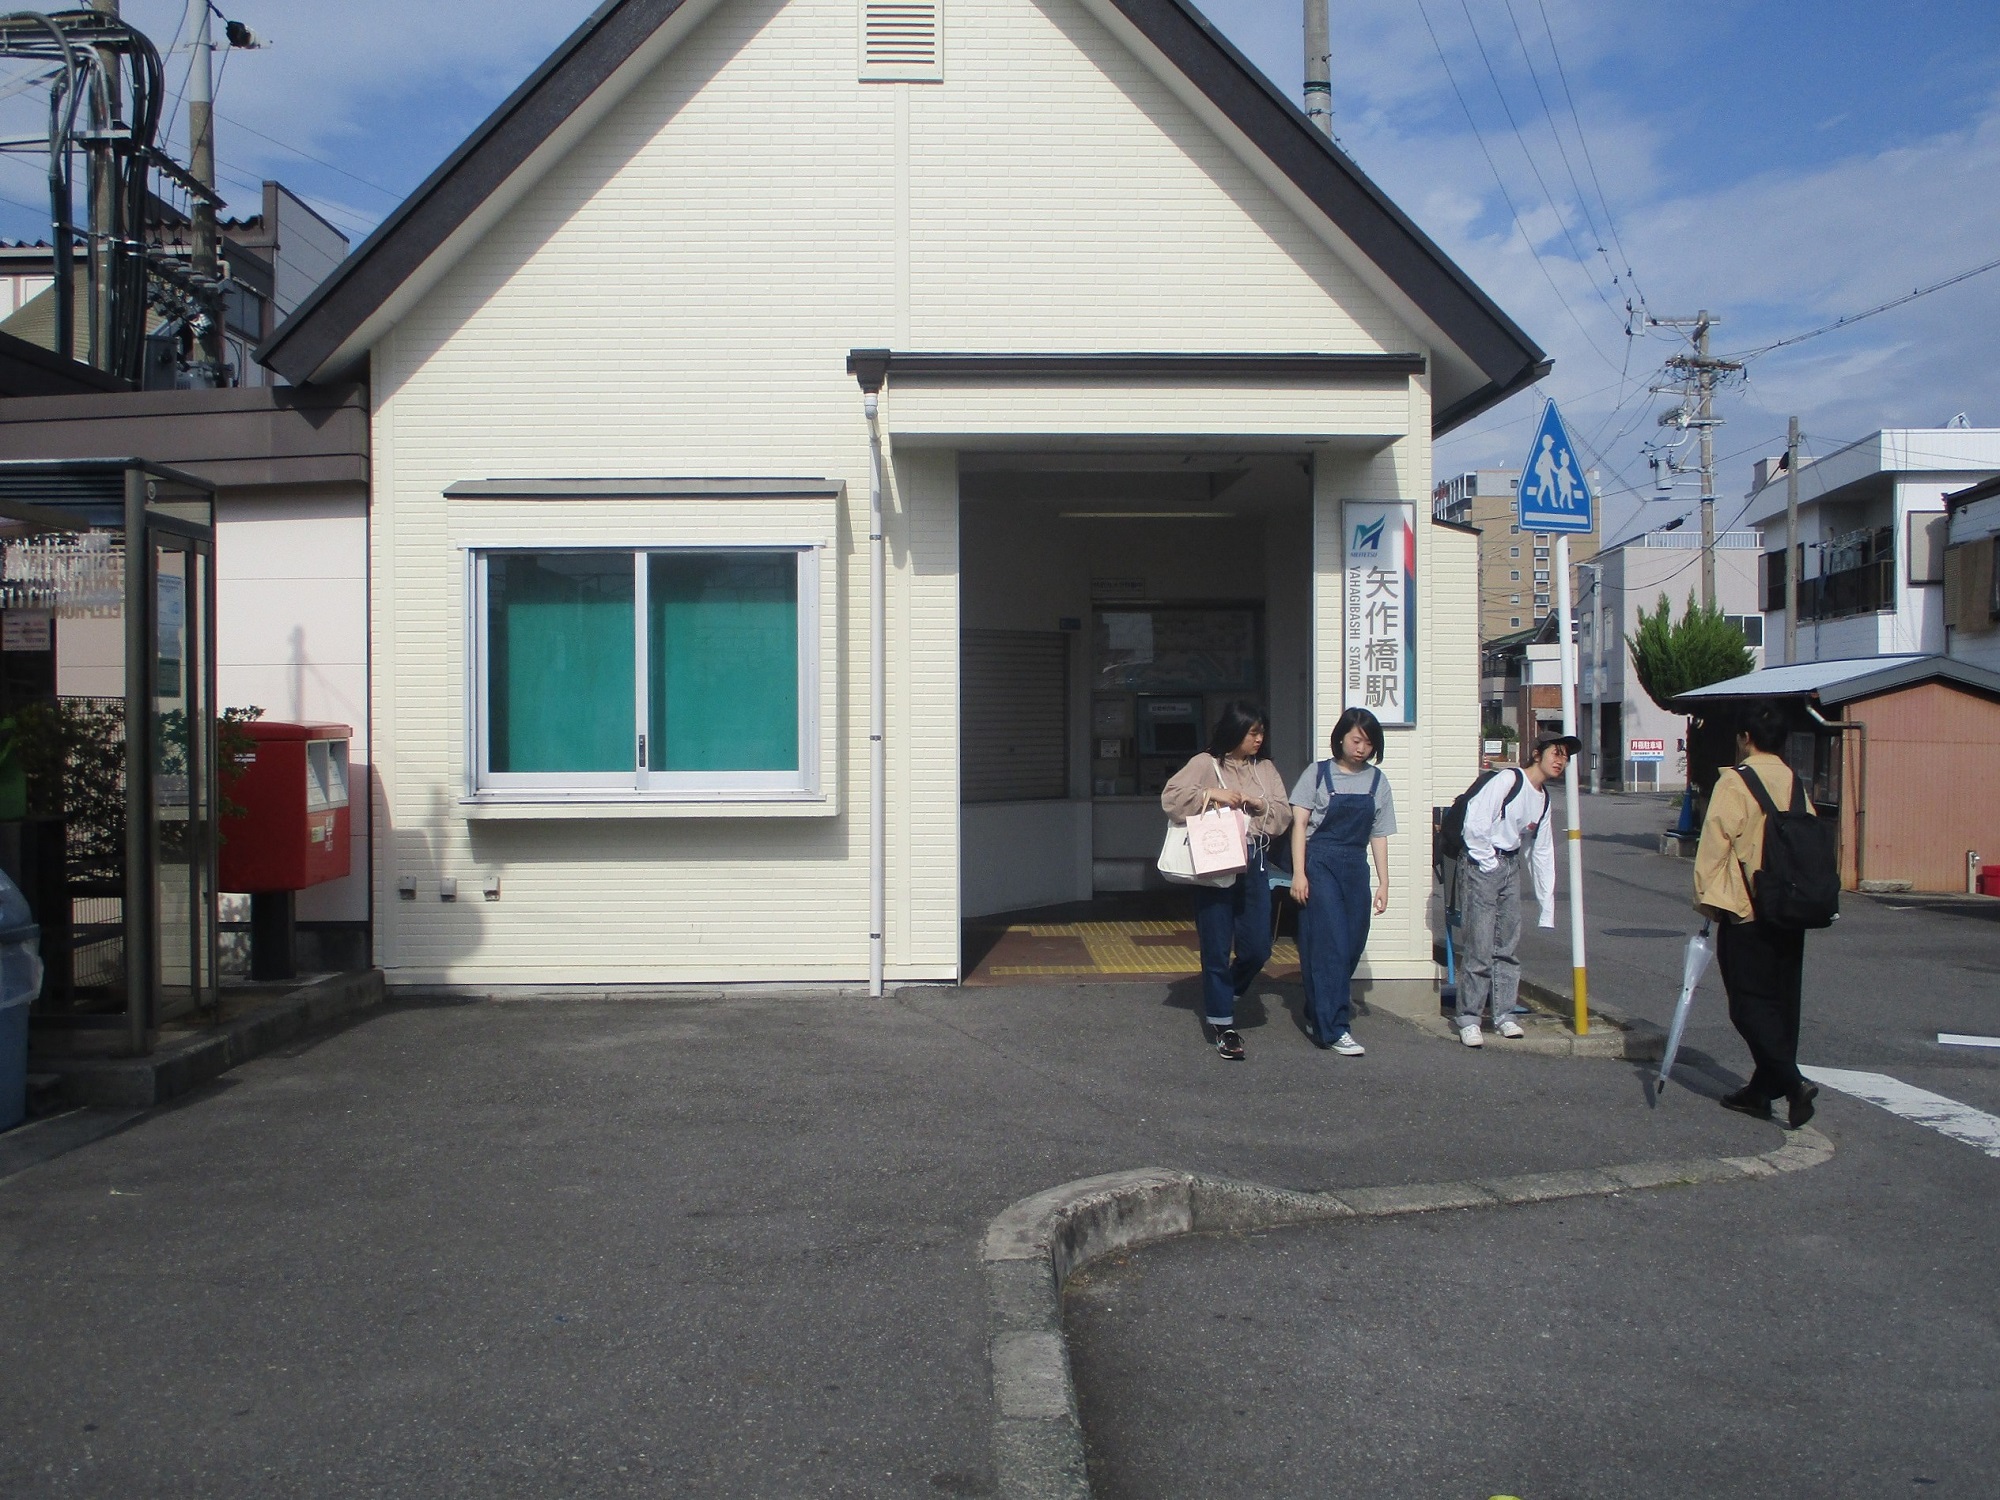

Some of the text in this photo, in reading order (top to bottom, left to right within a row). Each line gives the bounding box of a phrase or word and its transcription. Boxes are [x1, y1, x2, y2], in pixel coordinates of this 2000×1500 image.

[1349, 566, 1361, 690] YAHAGIBASHI STATION
[1365, 565, 1399, 708] 矢作橋駅
